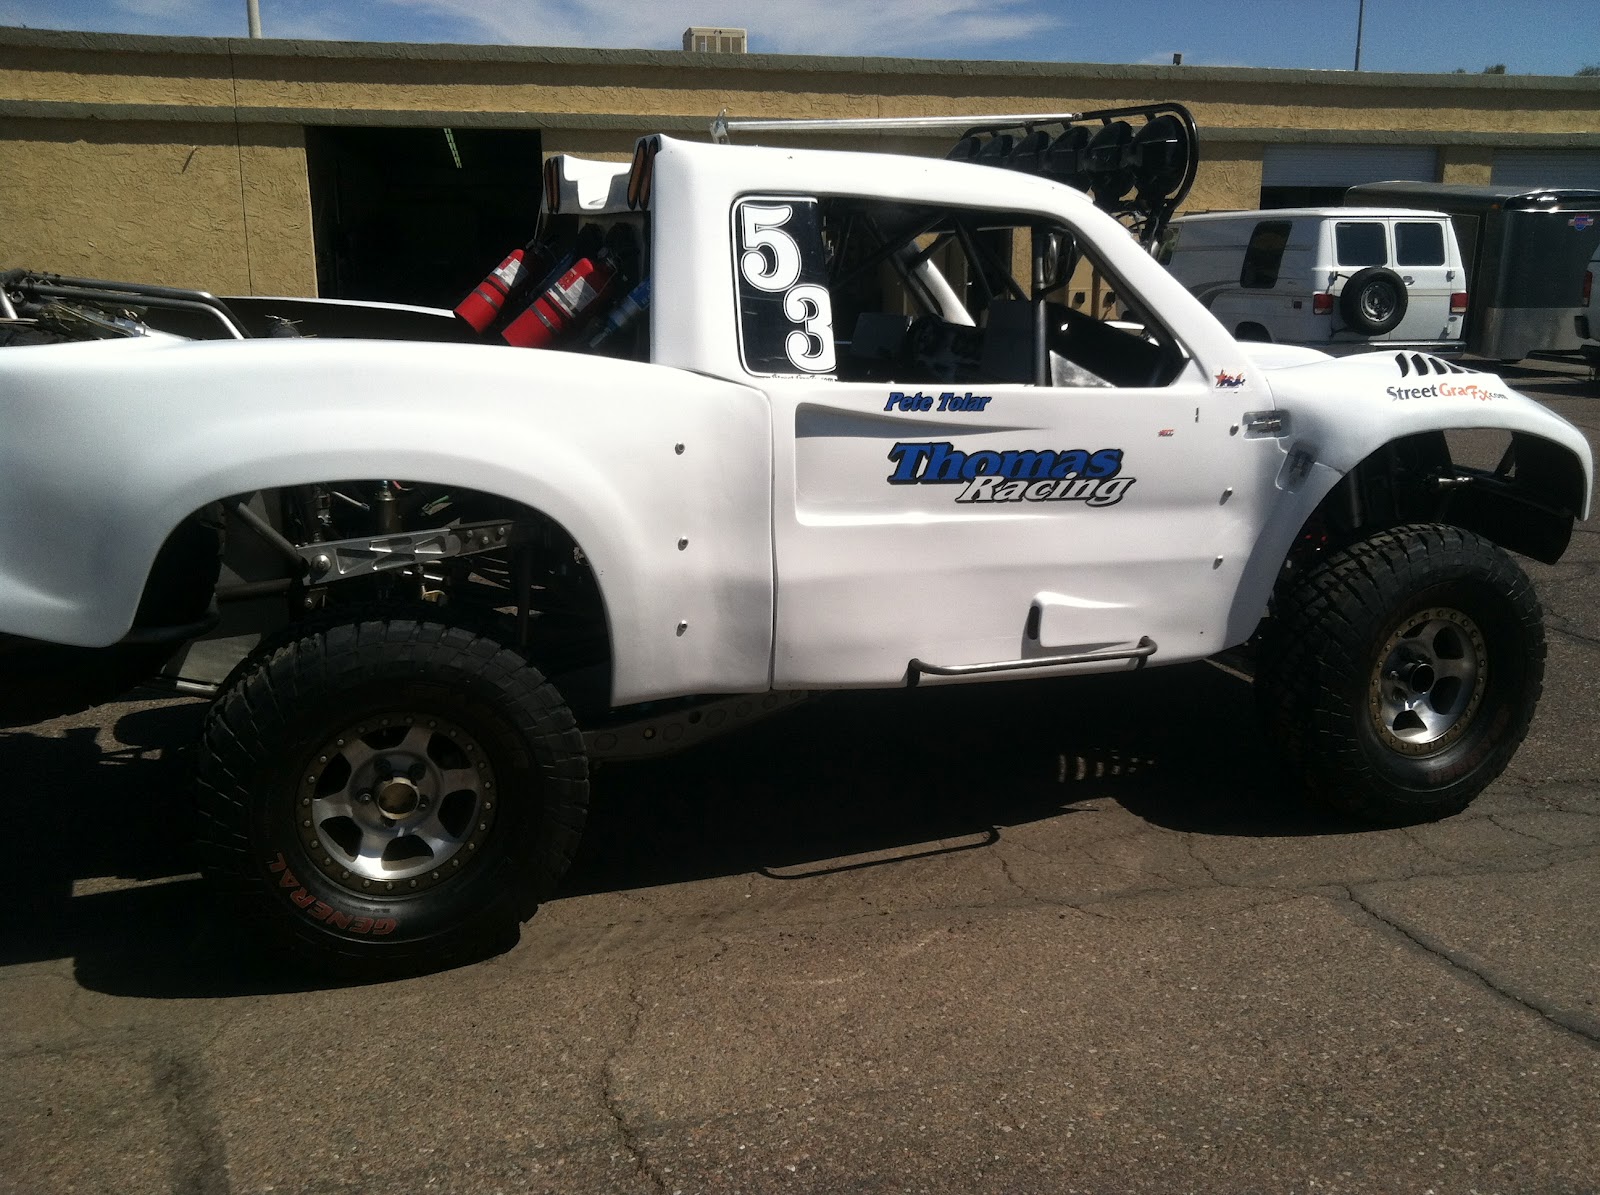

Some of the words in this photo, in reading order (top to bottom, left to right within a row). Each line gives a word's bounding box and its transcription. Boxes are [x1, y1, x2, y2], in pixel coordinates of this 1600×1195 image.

[883, 391, 934, 412] Pete
[936, 391, 992, 412] Tolar
[887, 442, 1124, 485] Thomas
[955, 472, 1136, 507] Racing
[269, 852, 398, 935] GENERAL
